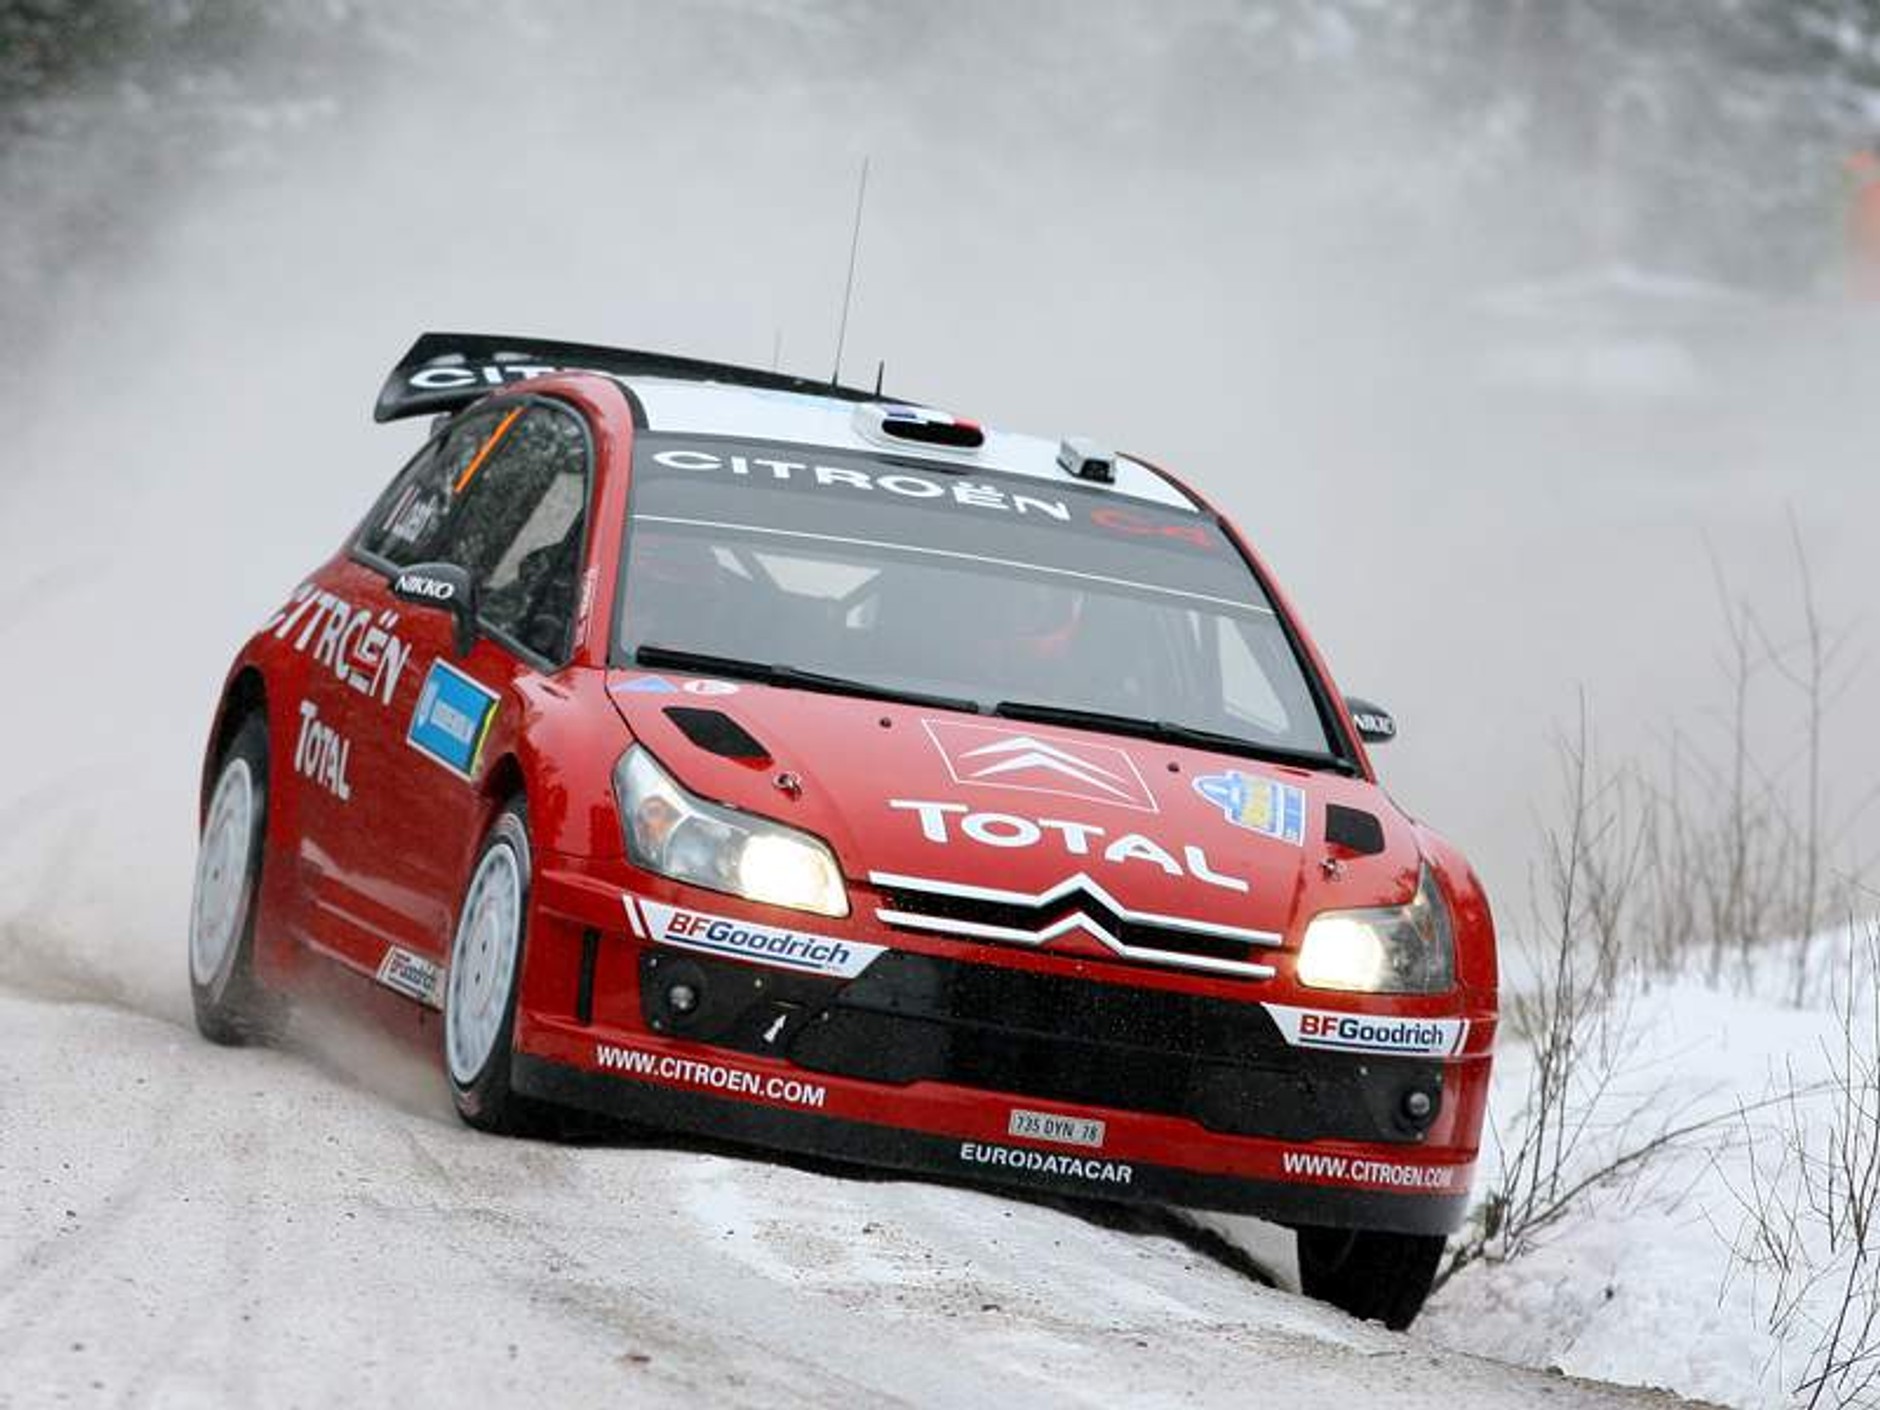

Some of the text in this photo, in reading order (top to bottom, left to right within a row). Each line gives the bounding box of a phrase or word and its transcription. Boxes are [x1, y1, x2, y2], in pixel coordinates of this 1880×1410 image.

[409, 366, 556, 388] CIT
[653, 449, 1071, 521] CITROËN
[395, 576, 454, 599] NIKKO
[295, 699, 350, 800] TOTAL
[890, 799, 1249, 892] TOTAL
[667, 912, 850, 965] BFGoodrich
[1301, 1014, 1443, 1045] BFGoodrich
[597, 1045, 825, 1107] WWW.CITROEN.COM
[1017, 1116, 1098, 1142] 735 DYN 78
[961, 1143, 1132, 1183] EURODATACAR
[1283, 1152, 1453, 1187] WWW.CITROEN.COM
